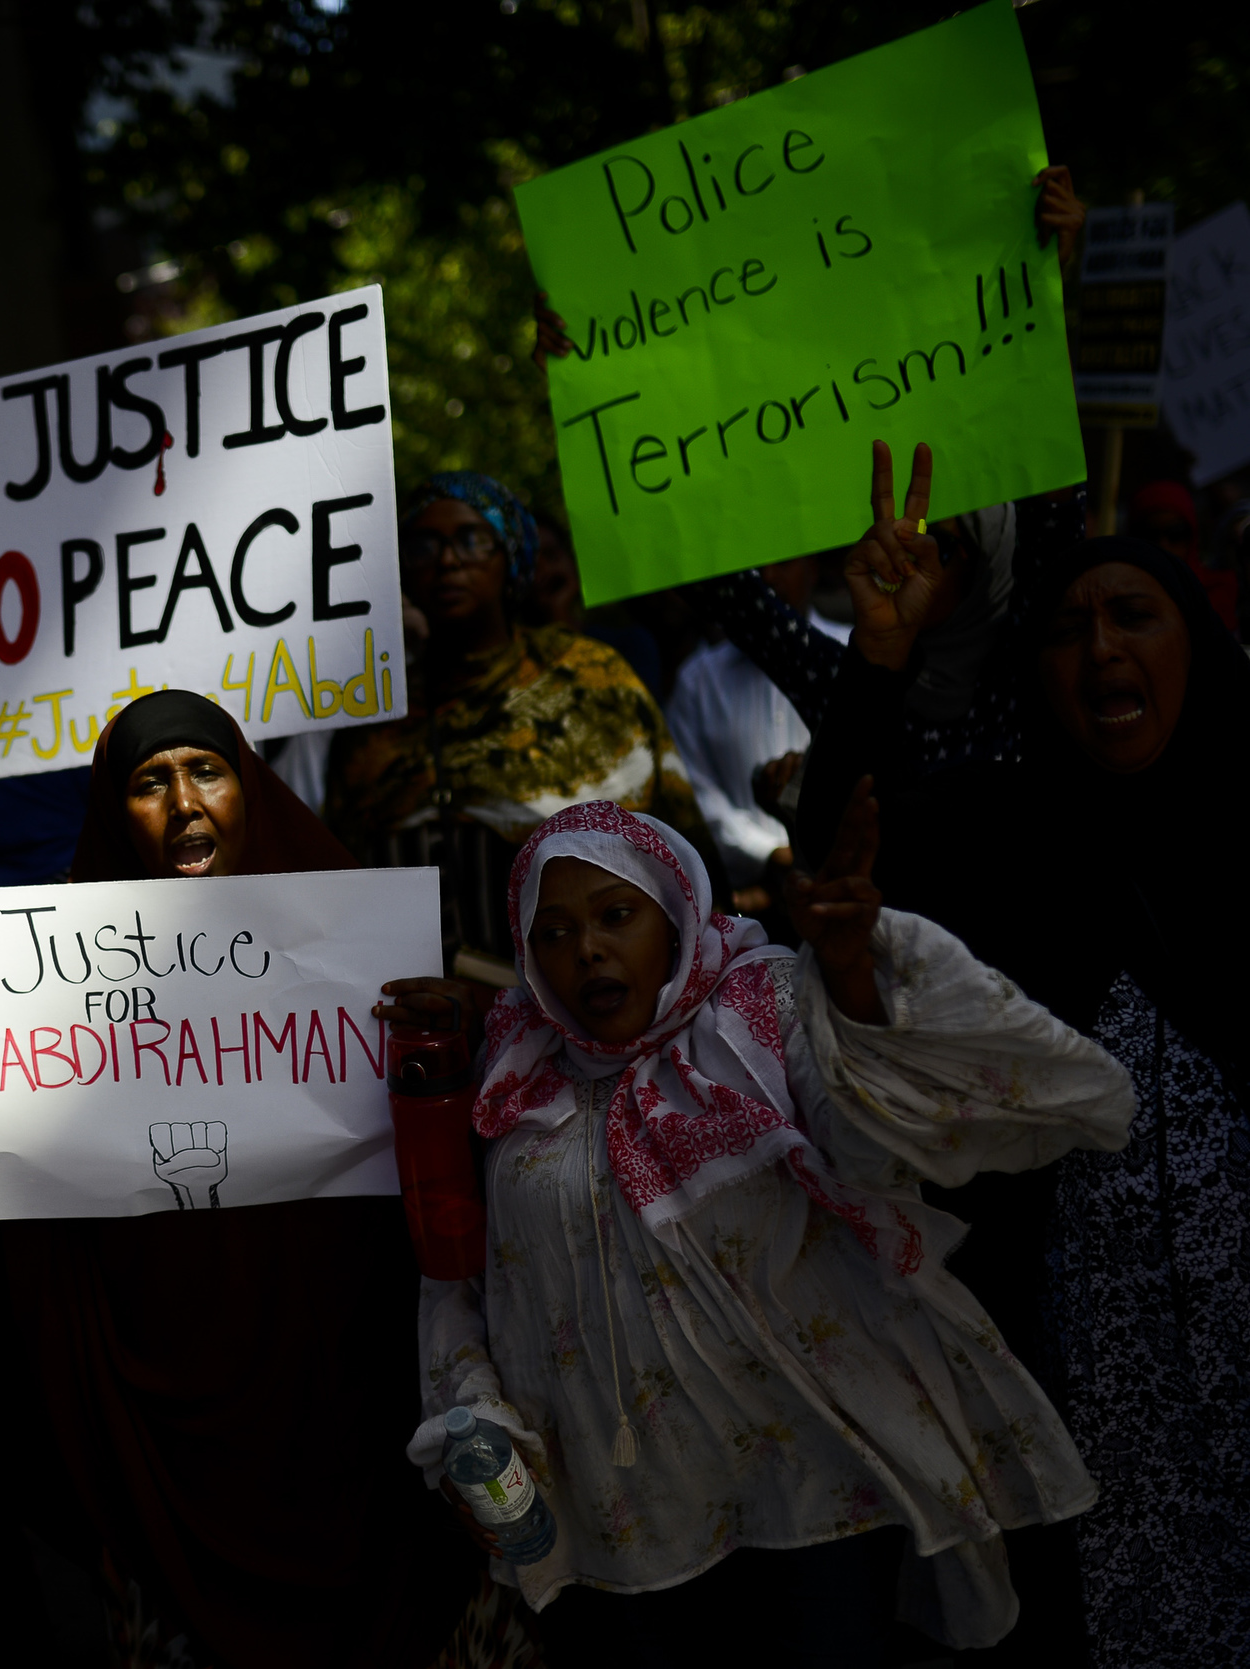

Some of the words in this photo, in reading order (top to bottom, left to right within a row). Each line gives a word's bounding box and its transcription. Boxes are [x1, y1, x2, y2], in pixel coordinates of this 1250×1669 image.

[602, 128, 826, 254] Police
[811, 214, 873, 269] is
[2, 303, 386, 501] JUSTICE
[62, 492, 374, 657] PEACE
[0, 1000, 386, 1092] ABDIRAHMAN
[84, 986, 162, 1024] FOR
